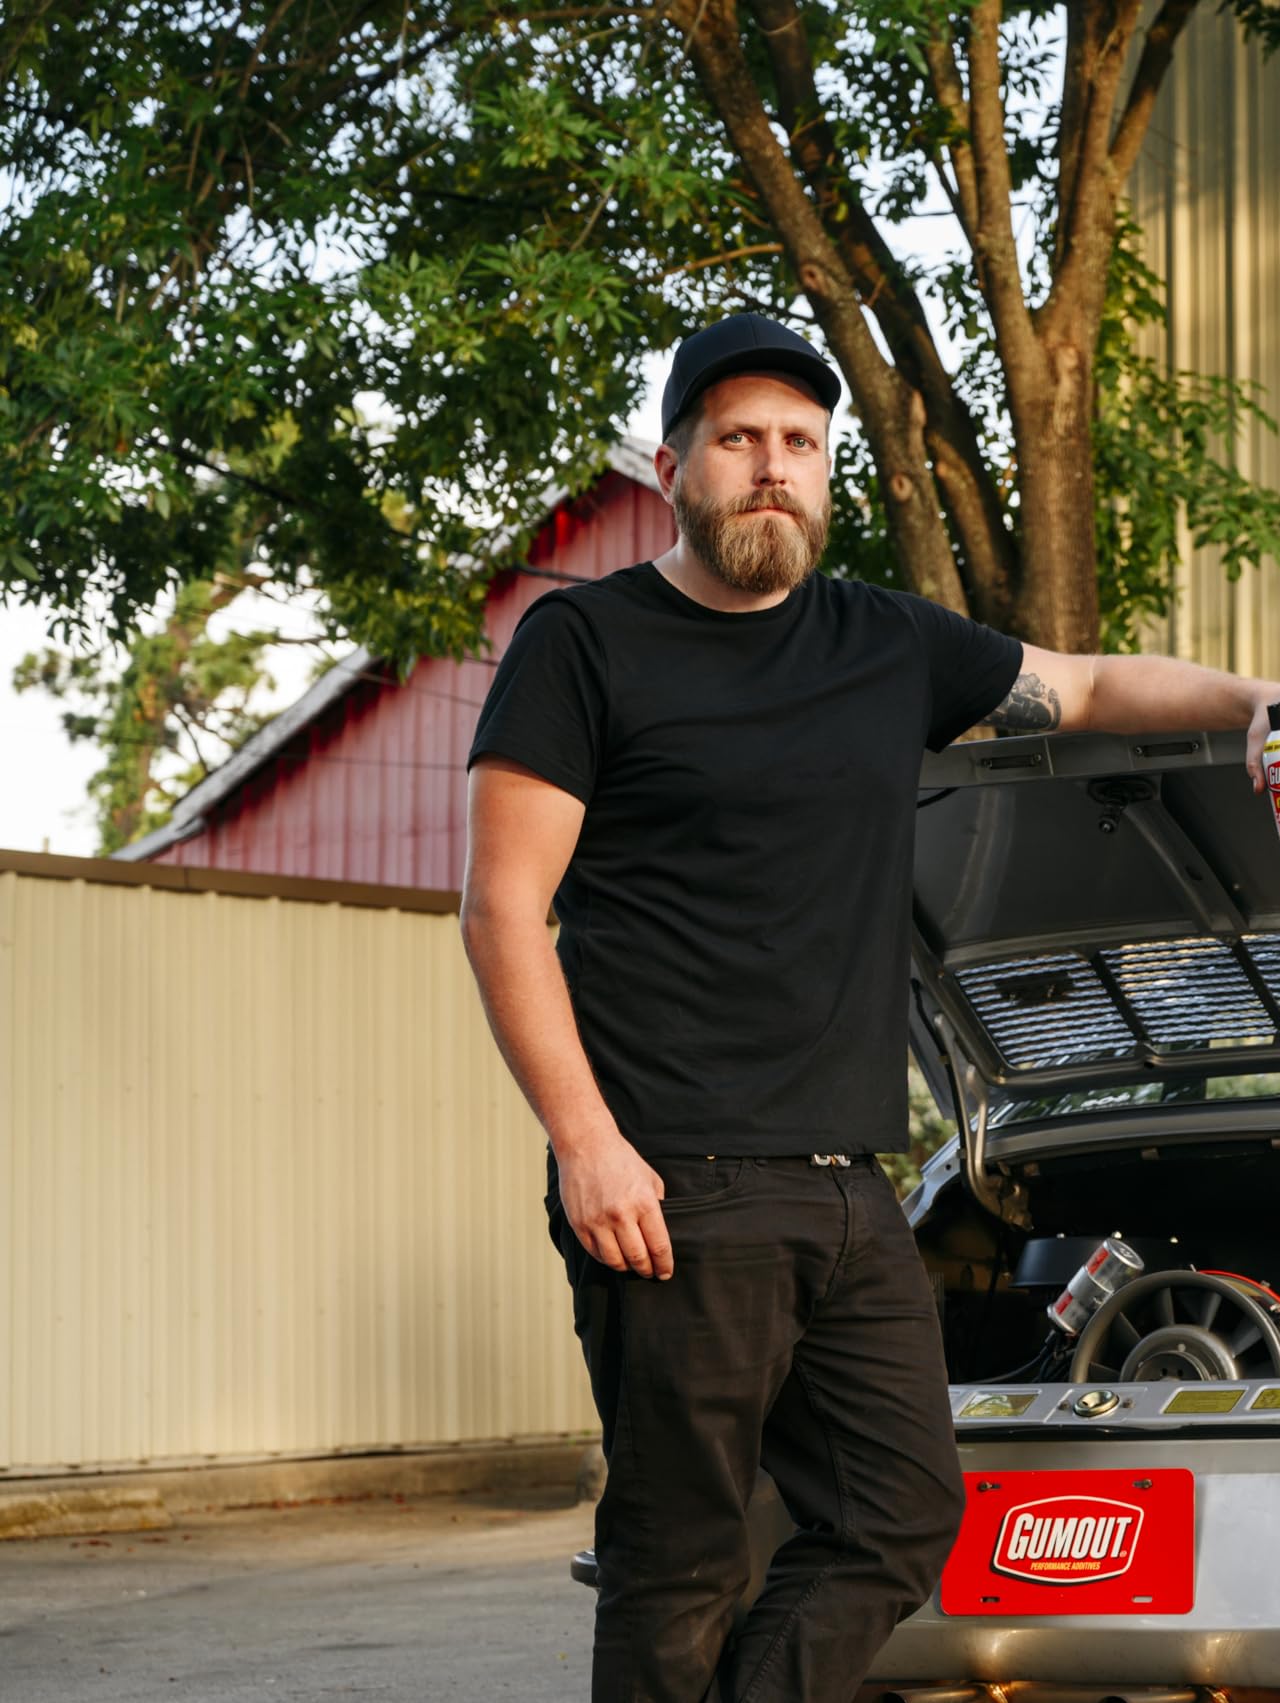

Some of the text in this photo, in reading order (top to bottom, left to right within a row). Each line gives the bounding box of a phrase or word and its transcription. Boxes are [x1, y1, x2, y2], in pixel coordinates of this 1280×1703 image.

[1007, 1512, 1133, 1561] GUMOUT
[1030, 1561, 1101, 1571] PERFORMANCE ADDITIVES
